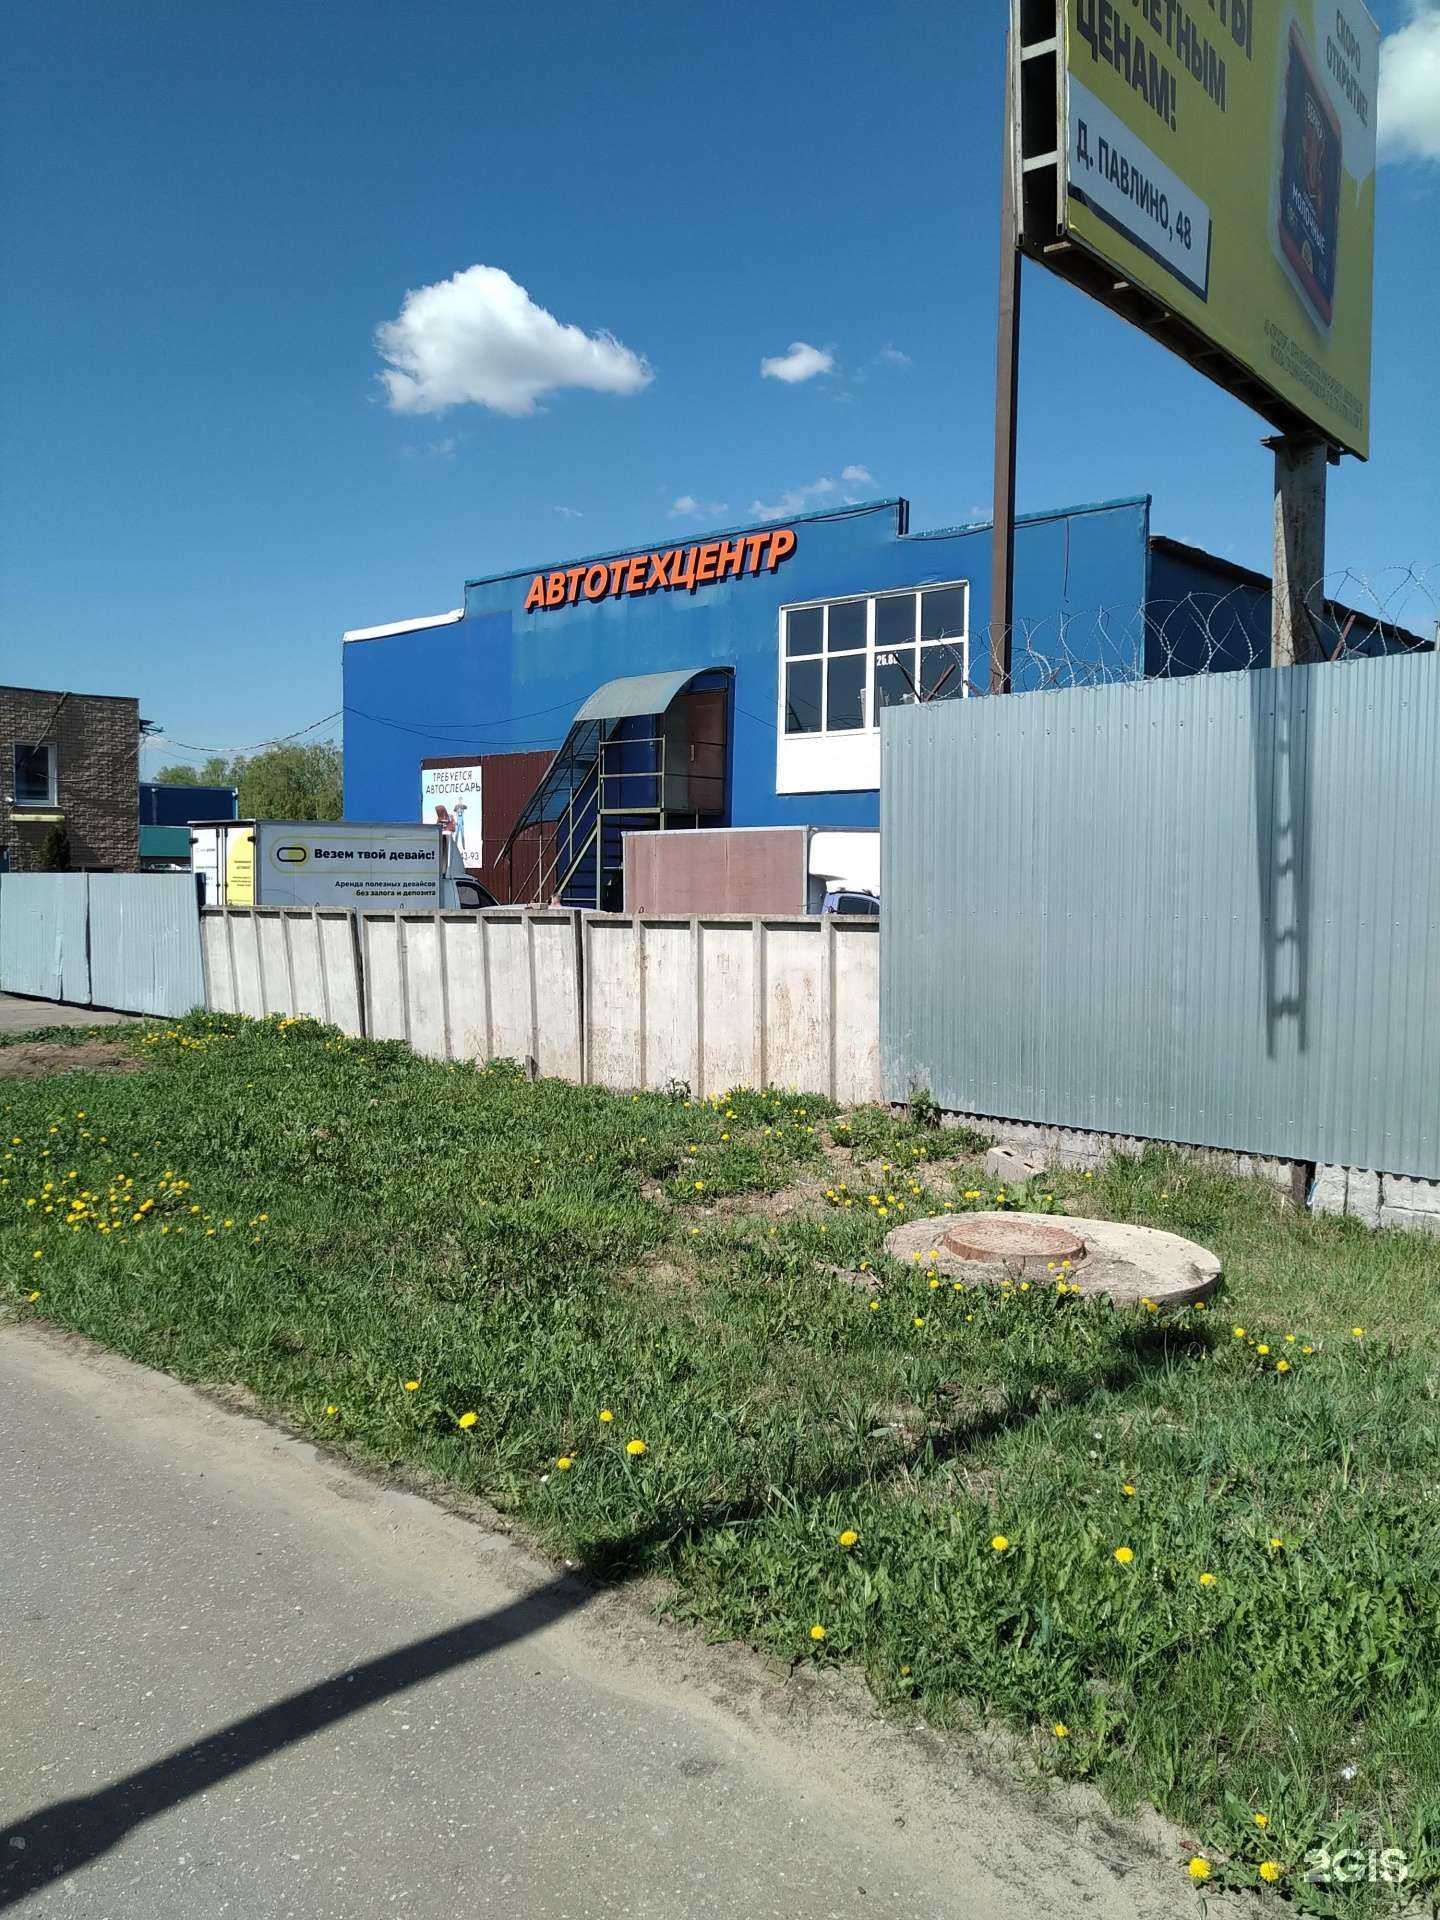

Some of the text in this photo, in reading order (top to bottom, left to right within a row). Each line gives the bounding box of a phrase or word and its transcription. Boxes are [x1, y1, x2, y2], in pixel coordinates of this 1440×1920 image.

[1076, 0, 1176, 132] ЦЕНАМ!
[1077, 118, 1192, 250] Д. ПАВЛИНО, 48
[523, 529, 797, 610] АВТОТЕХЦЕНТР
[433, 770, 473, 782] ТРЕБУЕТСЯ
[425, 782, 481, 794] АВТОСЛЕСАРЬ
[314, 848, 435, 861] Везем твой девайс!
[334, 880, 364, 889] Аренда
[402, 880, 436, 889] девайсов
[403, 889, 436, 897] депозита
